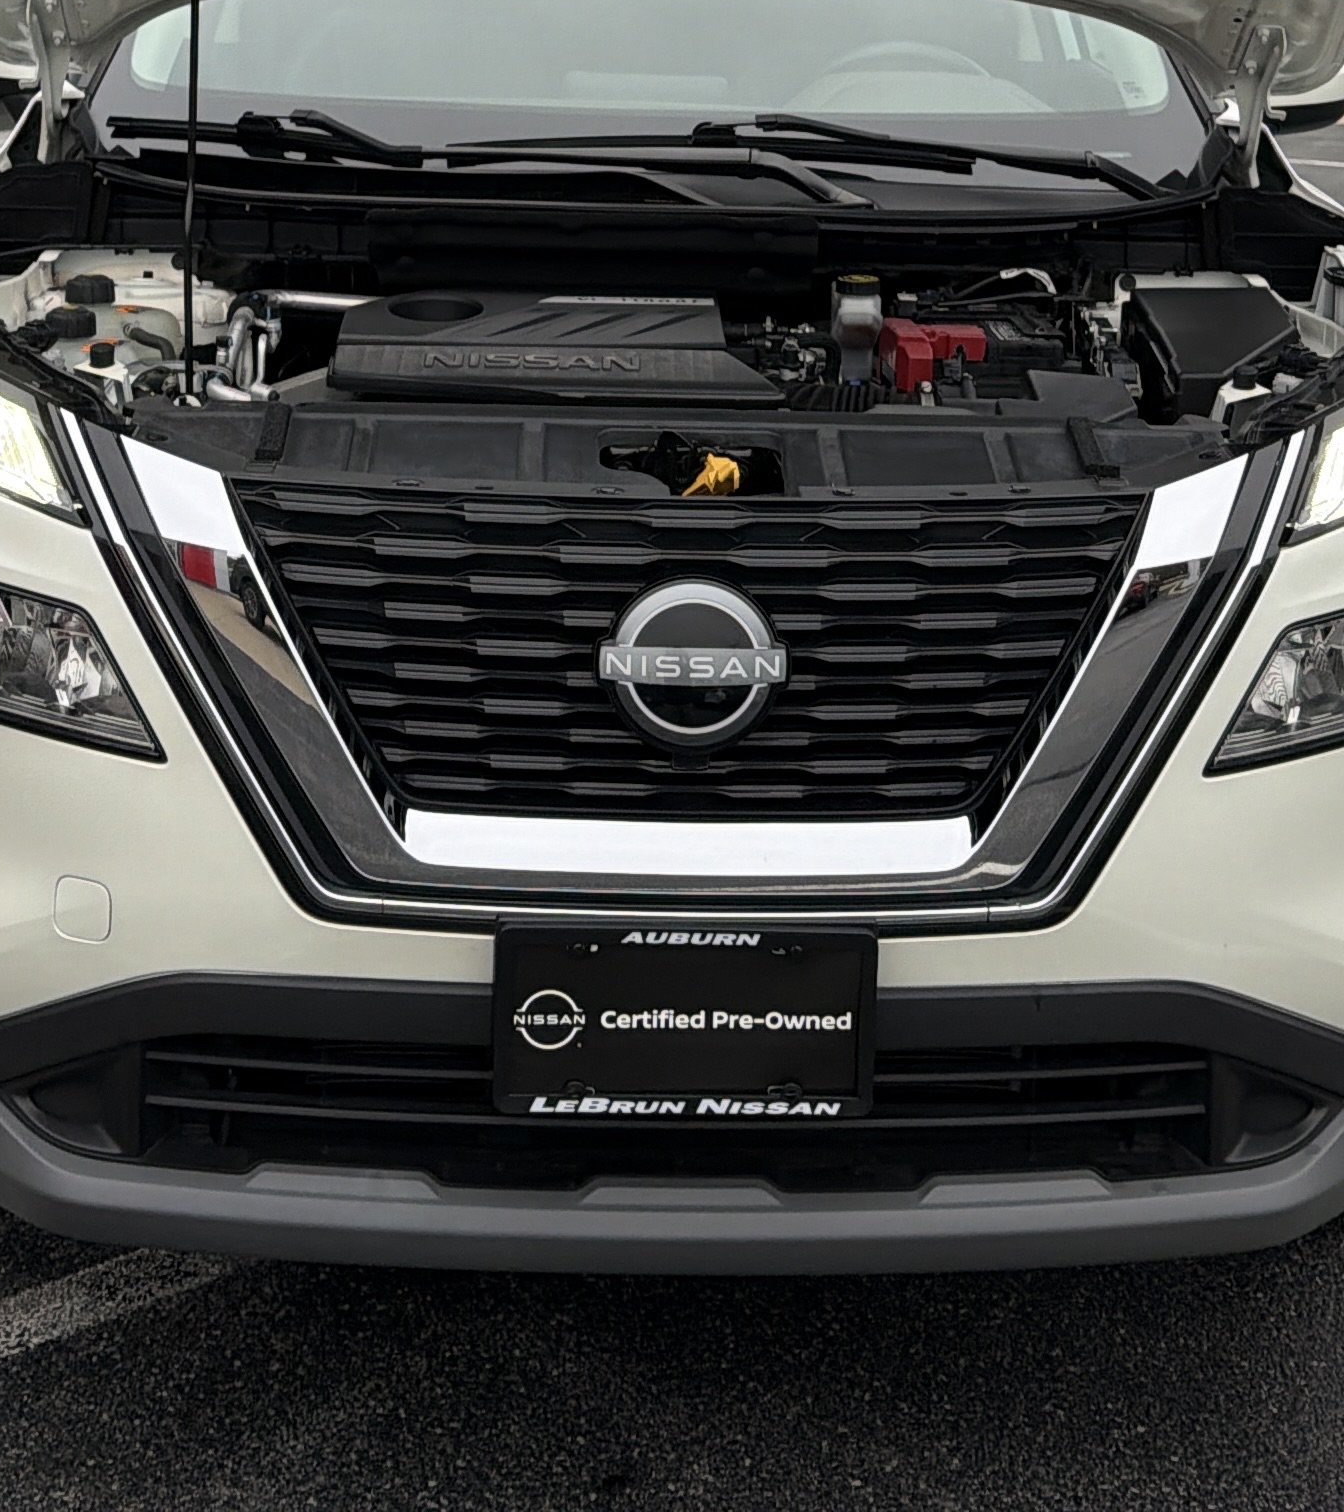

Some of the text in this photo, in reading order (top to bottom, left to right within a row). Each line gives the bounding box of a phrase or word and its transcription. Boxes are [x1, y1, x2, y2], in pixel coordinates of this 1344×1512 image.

[423, 352, 641, 372] NISSAN
[606, 652, 780, 679] NISSAN
[621, 931, 761, 947] AUBURN
[513, 1013, 585, 1026] NISSAN
[600, 1010, 852, 1030] Certified Pre-Owned
